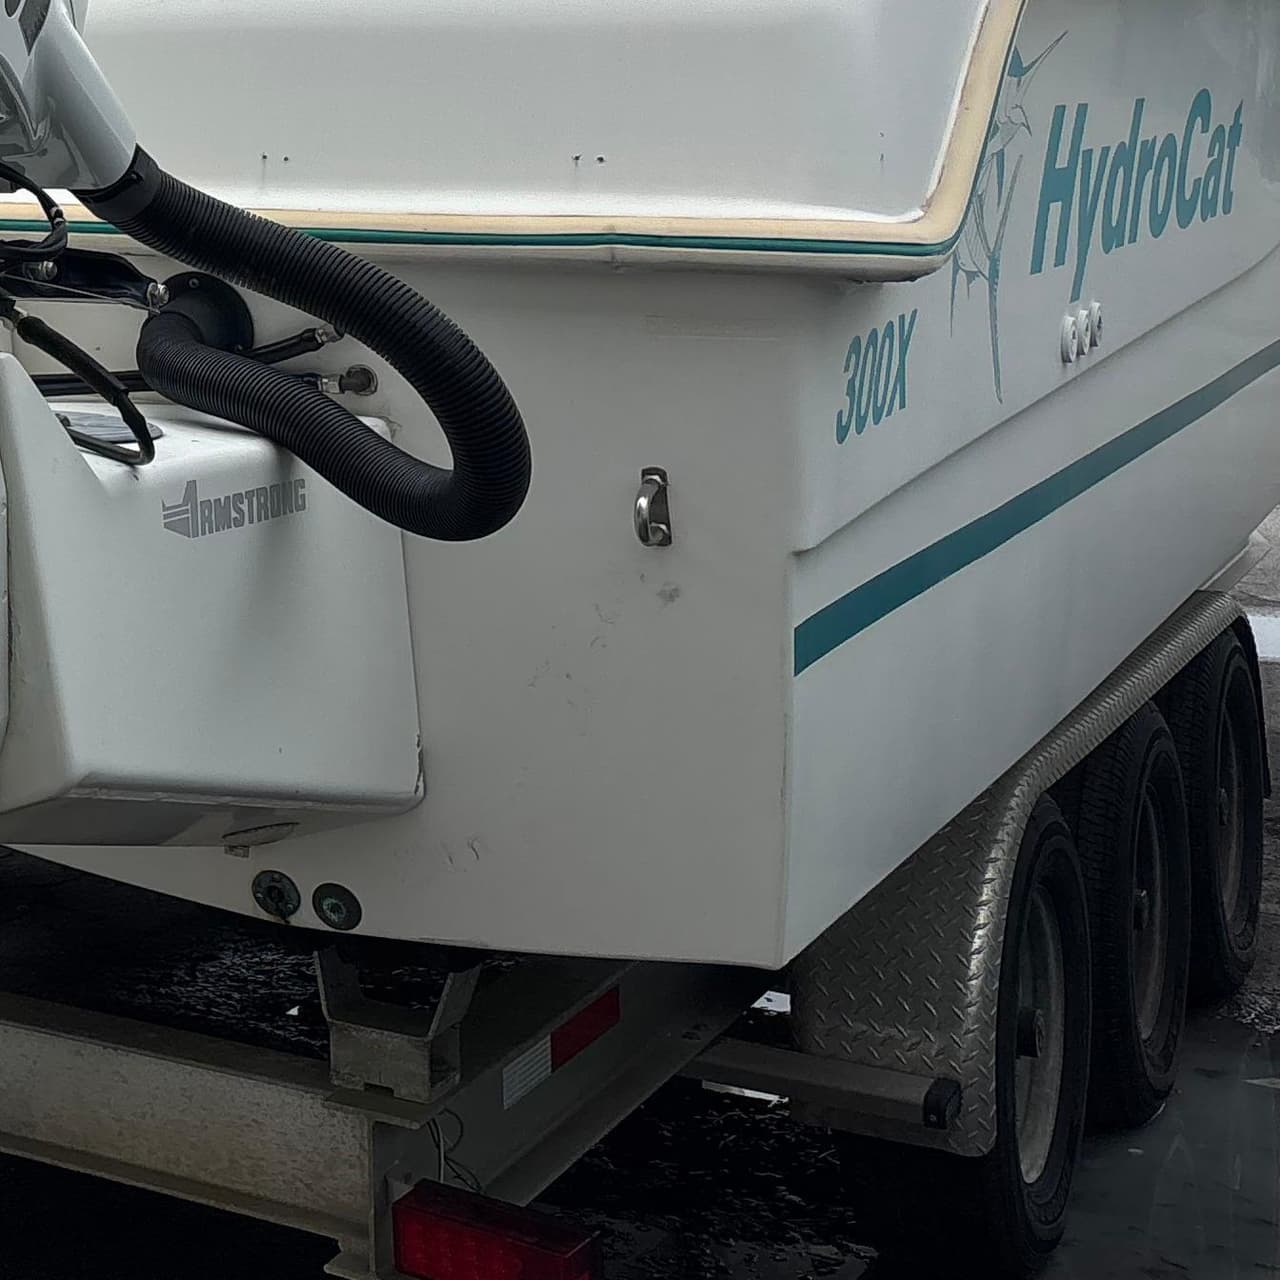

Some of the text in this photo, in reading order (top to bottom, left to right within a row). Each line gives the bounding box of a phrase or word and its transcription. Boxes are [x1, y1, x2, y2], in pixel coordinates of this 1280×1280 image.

[1029, 88, 1243, 304] HydroCat
[836, 308, 918, 445] 300X
[162, 479, 307, 539] ARMSTRONG
